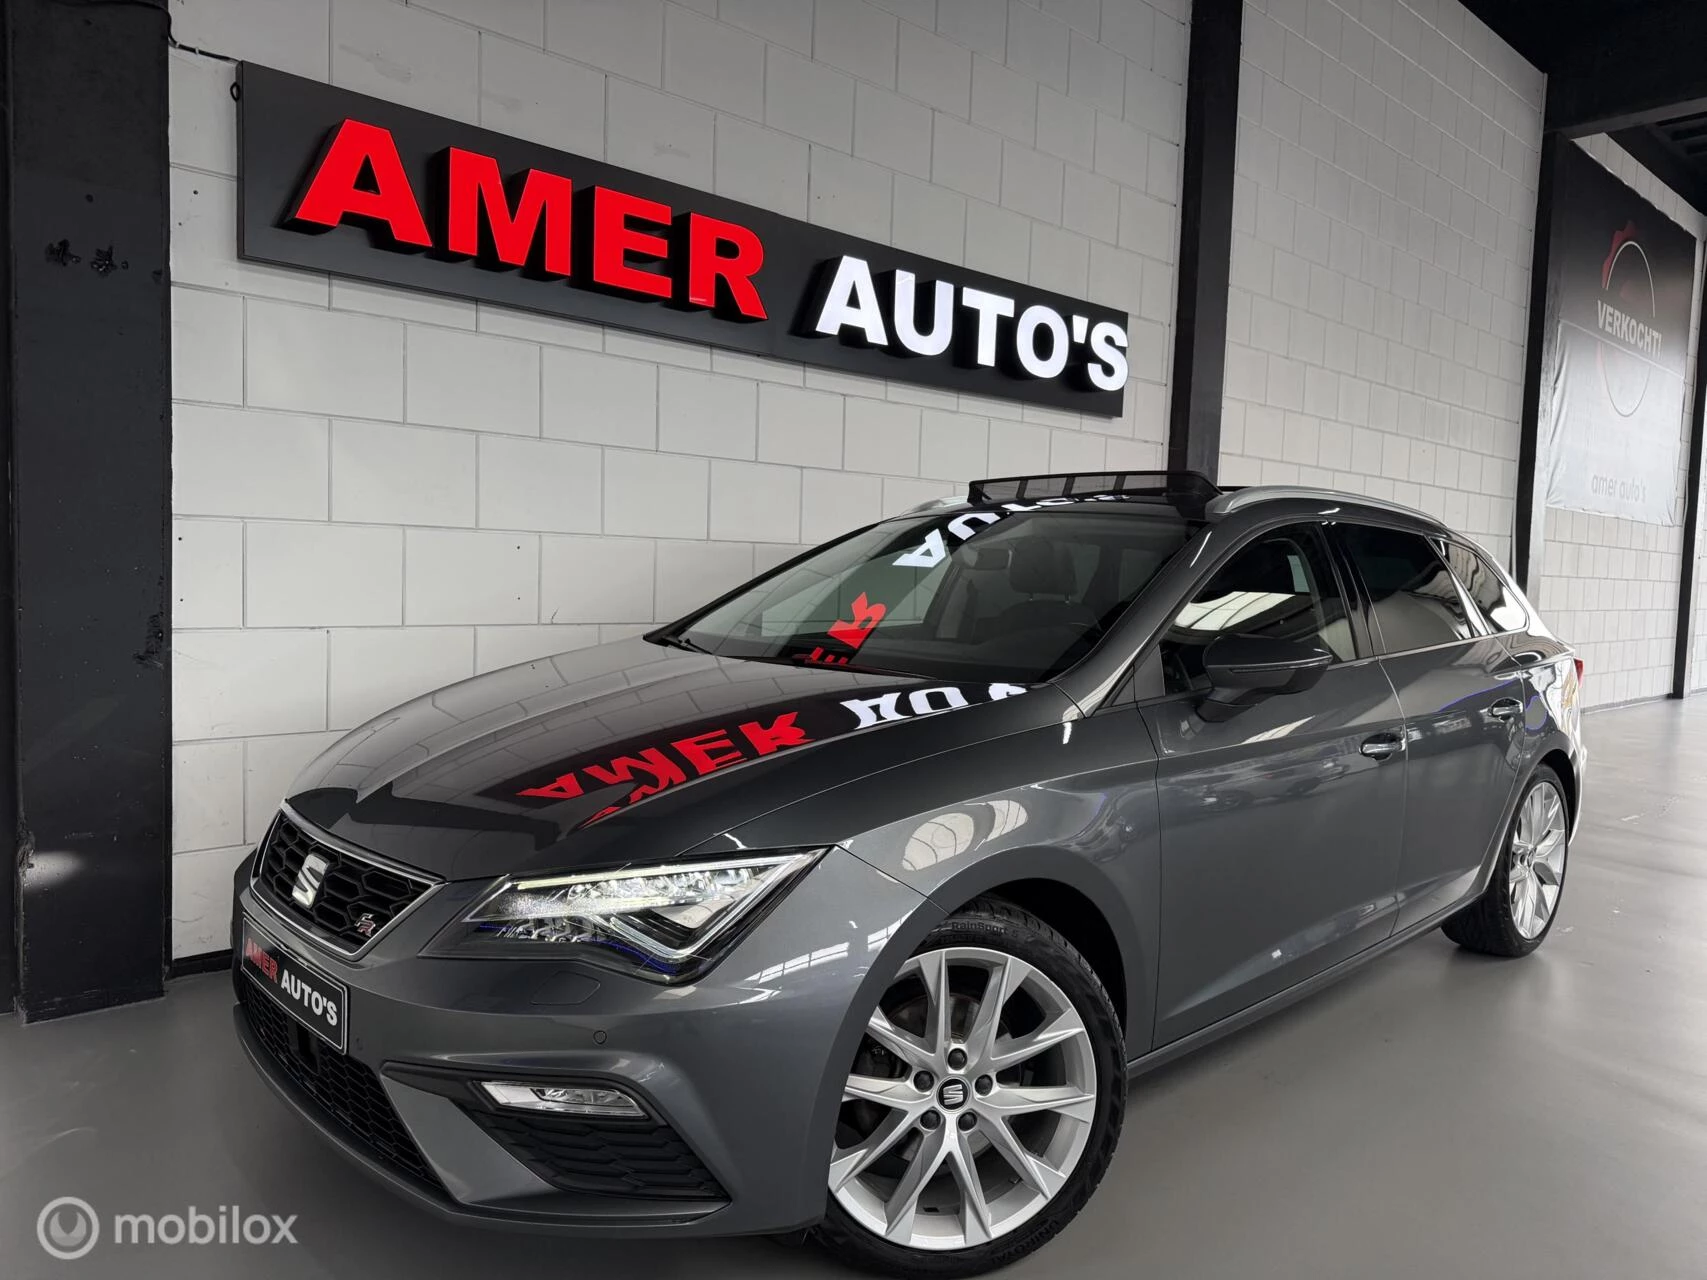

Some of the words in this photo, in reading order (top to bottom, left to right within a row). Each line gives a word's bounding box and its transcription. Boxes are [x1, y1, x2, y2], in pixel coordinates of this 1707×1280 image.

[295, 119, 768, 319] AMER
[815, 255, 1129, 392] AUTO'S
[1597, 299, 1662, 360] VERKOCHT!
[1591, 474, 1617, 497] amer
[1619, 476, 1646, 503] auto's
[246, 938, 278, 984] AMER
[281, 969, 337, 1026] AUTO'S
